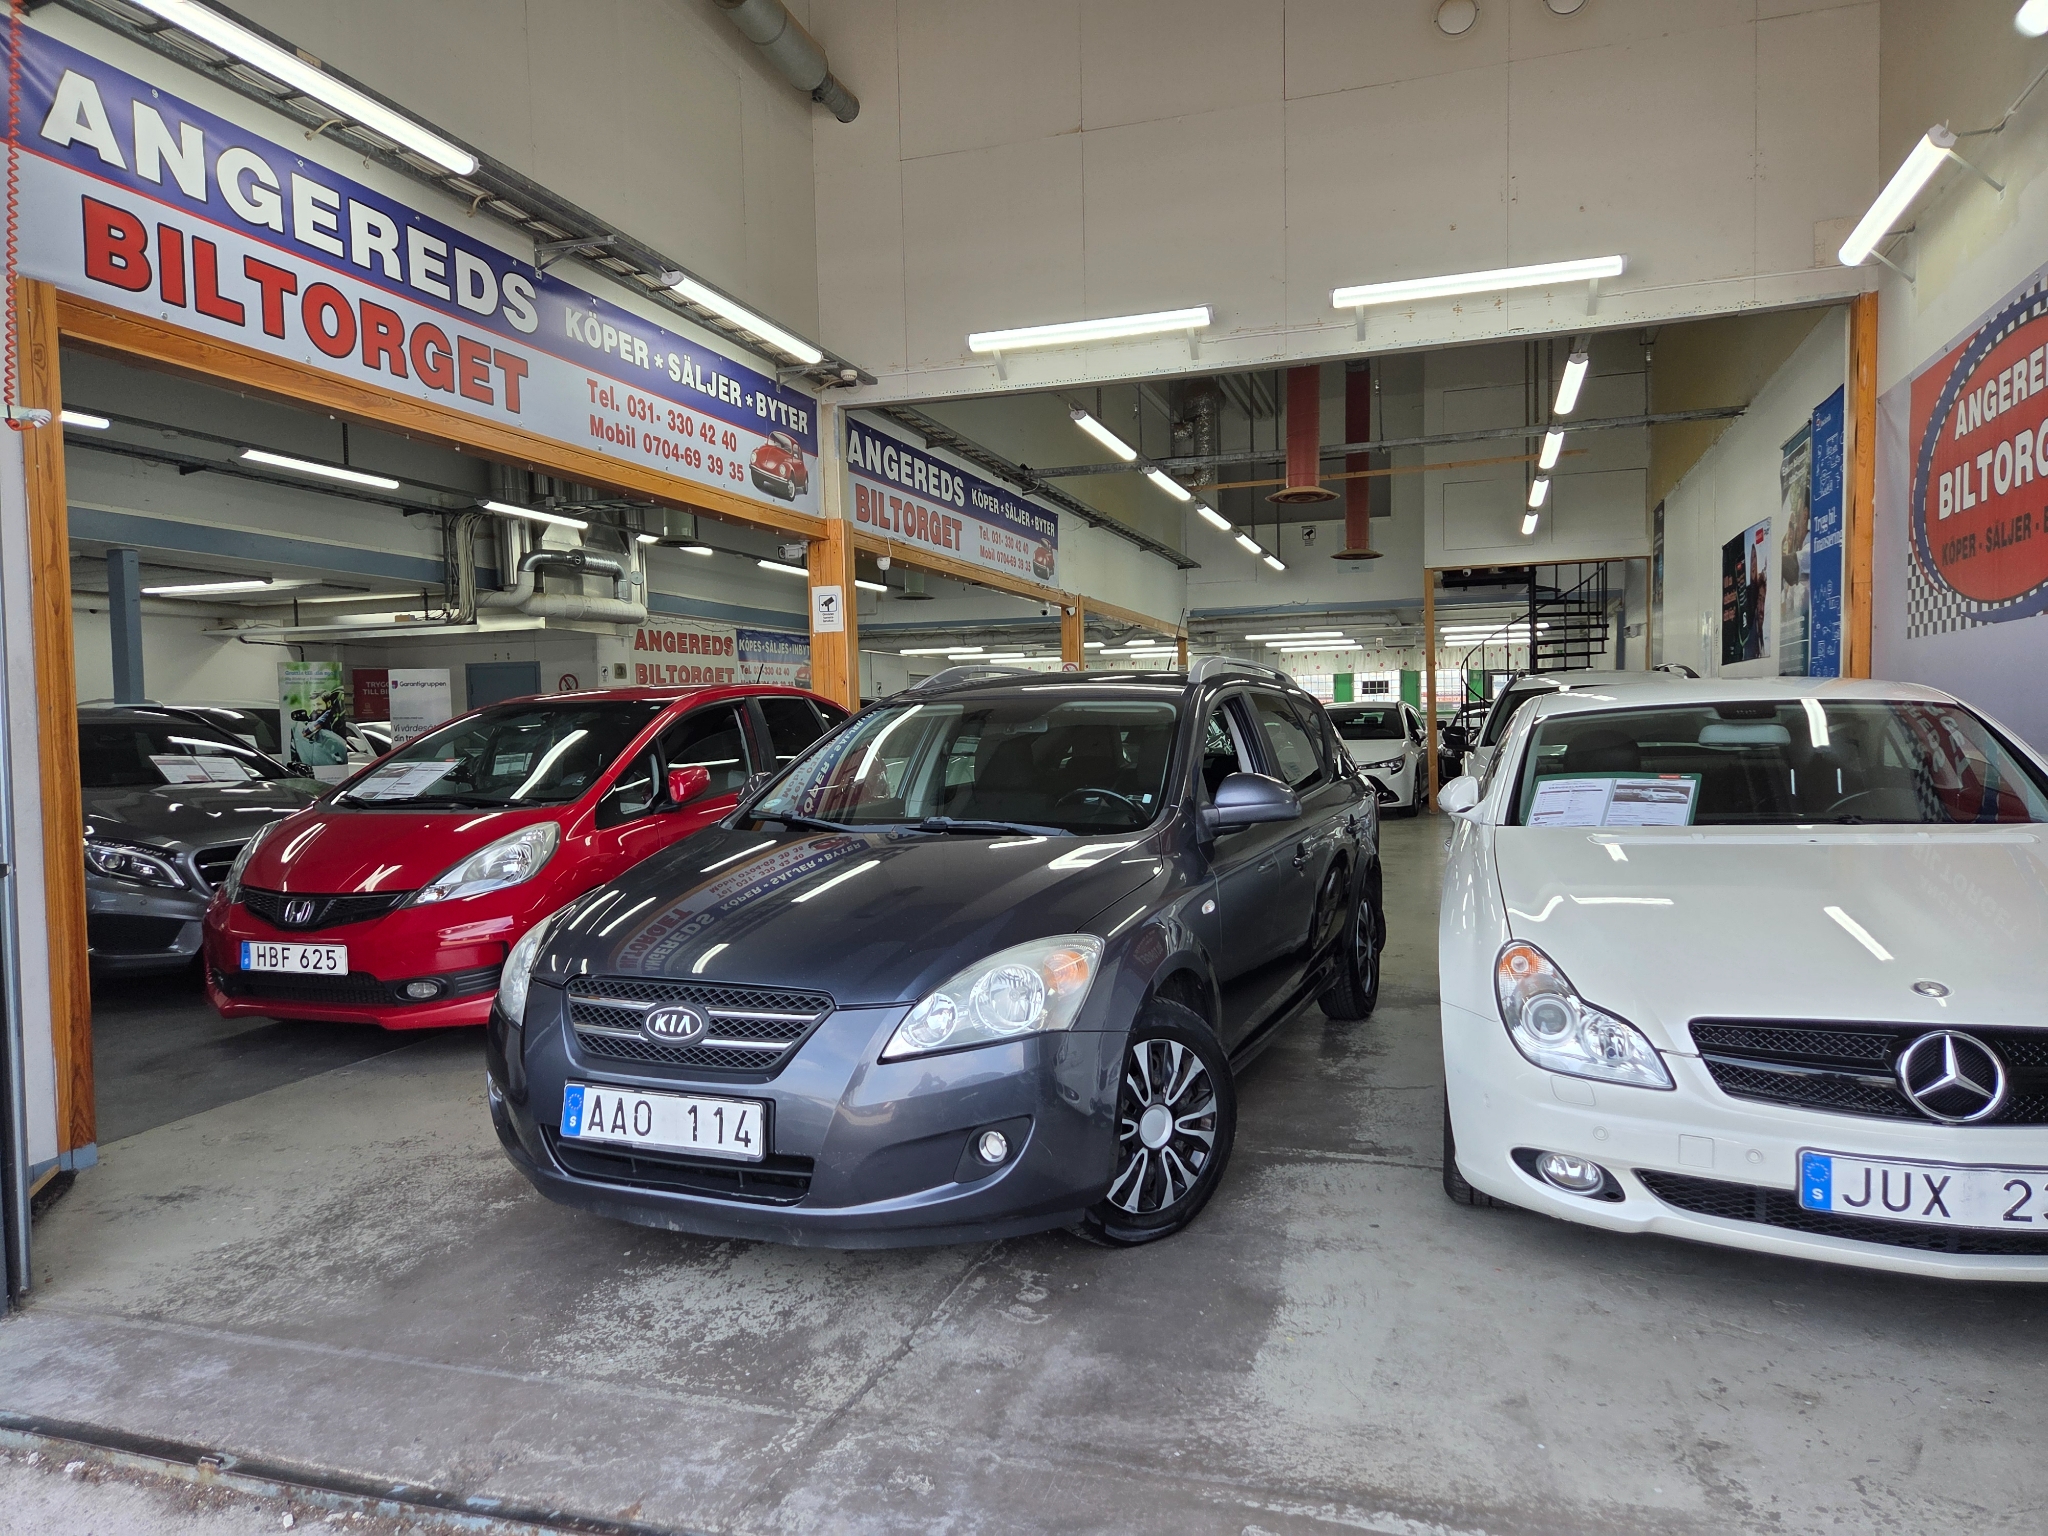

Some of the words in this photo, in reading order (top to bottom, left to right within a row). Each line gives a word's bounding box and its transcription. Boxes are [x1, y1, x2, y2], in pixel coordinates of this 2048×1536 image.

[40, 69, 538, 334] ANGEREDS
[82, 194, 528, 414] BILTORGET
[565, 307, 649, 369] KÖPER
[667, 353, 742, 408] SÄLJER
[755, 391, 808, 435] BYTER
[1954, 341, 2048, 440] ANGERE
[587, 378, 619, 412] Tel.
[627, 395, 660, 424] 031-
[667, 409, 694, 438] 330
[699, 422, 716, 446] 42
[721, 429, 737, 452] 40
[589, 414, 636, 449] Mobil
[643, 432, 701, 469] 0704-69
[707, 454, 724, 476] 39
[728, 461, 744, 482] 35
[847, 429, 965, 507] ANGEREDS
[855, 483, 962, 551] BILTORGET
[971, 488, 1000, 515] KÖPER
[1004, 502, 1031, 528] SÄLJER
[1034, 516, 1055, 537] BYTER
[979, 525, 990, 541] Tel.
[980, 545, 995, 561] Mobil
[1942, 532, 1976, 567] KÖPER
[1985, 512, 2032, 554] SÄLJER
[634, 628, 734, 657] ANGEREDS
[399, 681, 446, 689] Garantigruppen
[635, 663, 734, 685] BILTORGET
[394, 724, 400, 732] Vi
[257, 946, 290, 968] HBF
[300, 948, 337, 970] 625
[655, 1014, 691, 1034] KIA
[588, 1095, 652, 1136] AAO
[687, 1105, 751, 1148] 114
[1812, 1188, 1824, 1200] S
[1842, 1168, 1951, 1218] JUX
